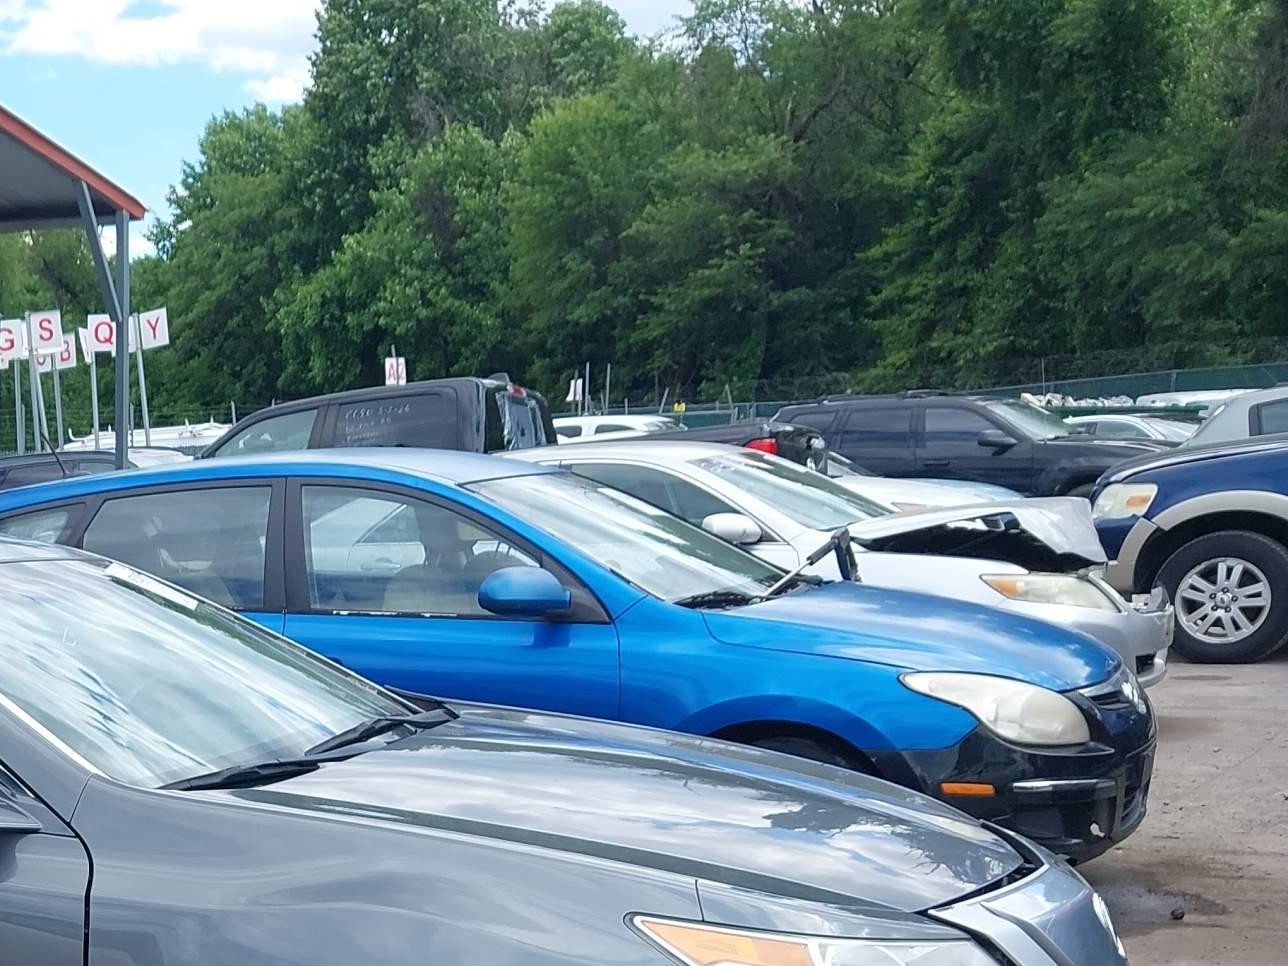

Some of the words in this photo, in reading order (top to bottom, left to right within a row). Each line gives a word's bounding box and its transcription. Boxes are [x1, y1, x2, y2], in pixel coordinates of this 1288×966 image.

[39, 318, 54, 341] S
[95, 321, 114, 345] Q
[147, 316, 160, 340] Y
